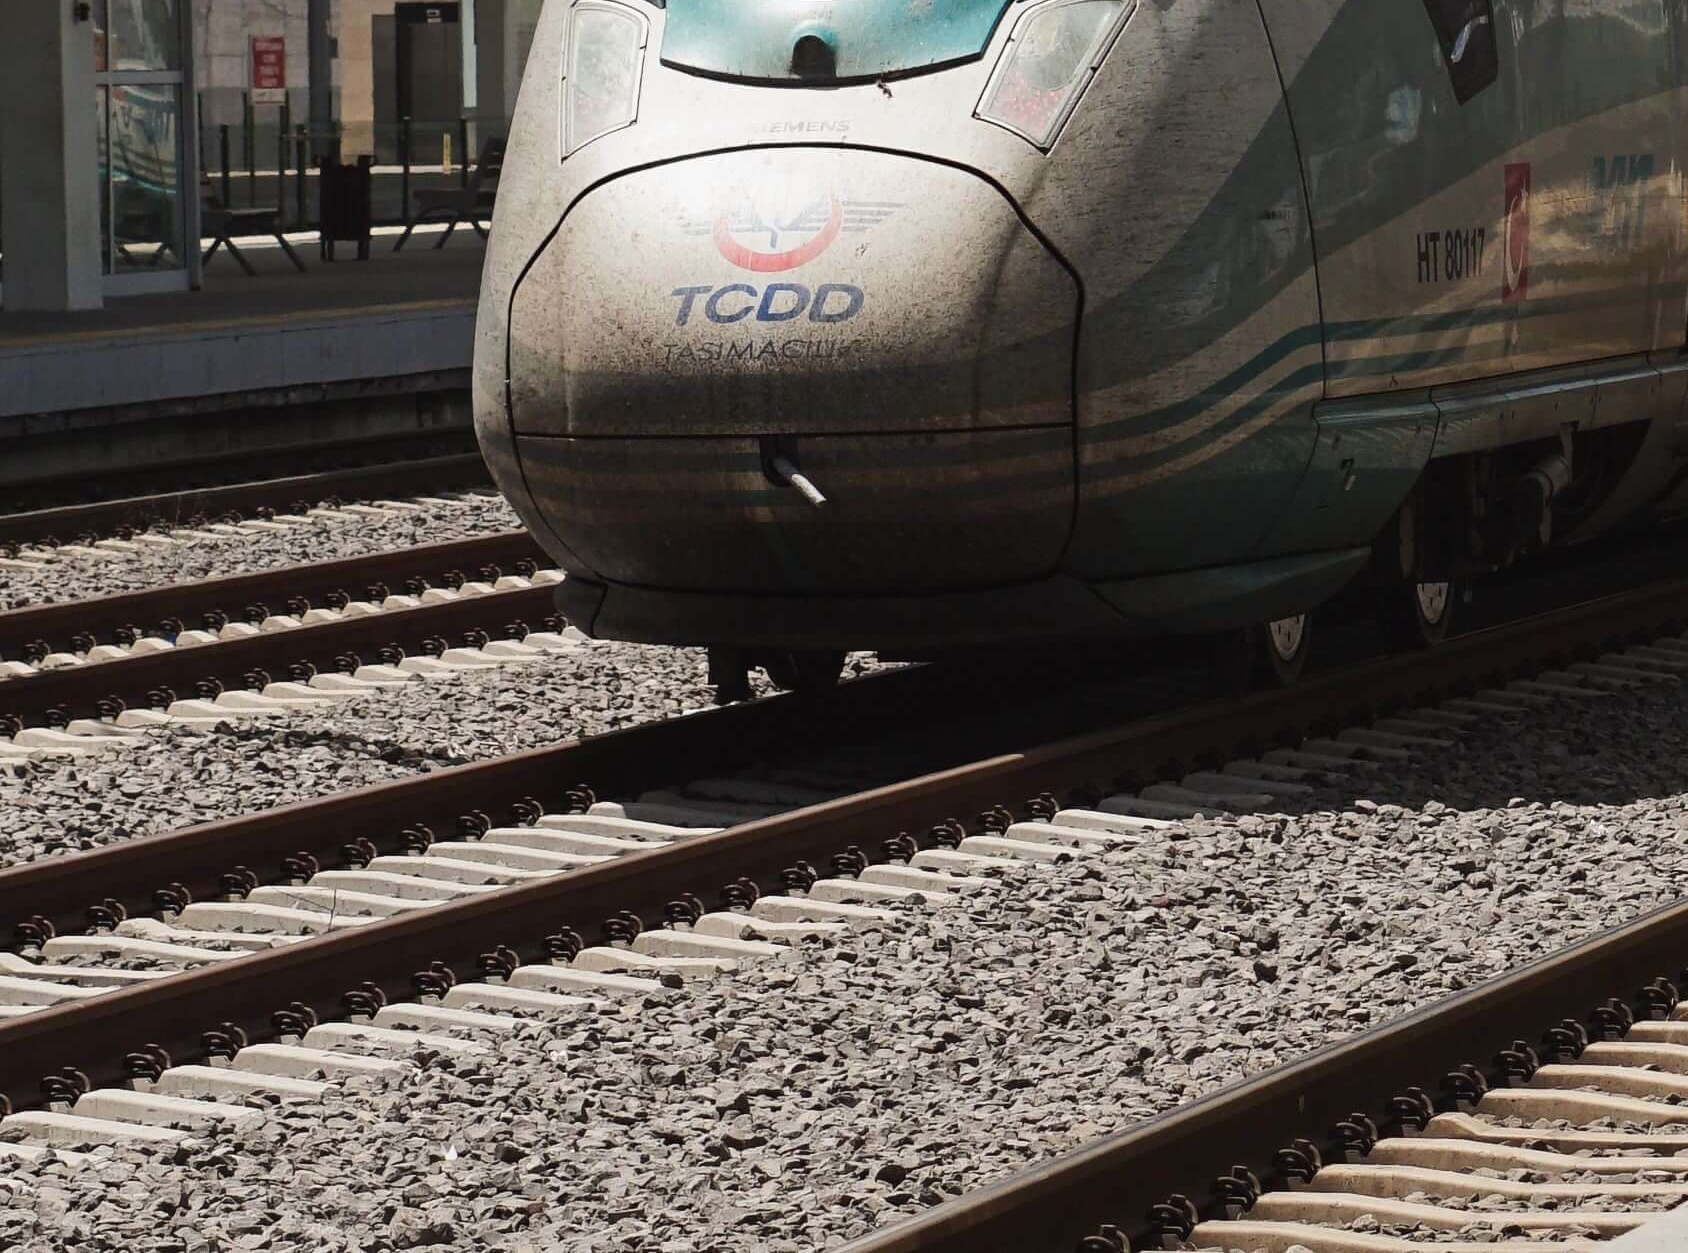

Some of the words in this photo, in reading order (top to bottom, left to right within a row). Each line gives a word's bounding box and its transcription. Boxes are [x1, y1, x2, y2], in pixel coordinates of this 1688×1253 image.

[1417, 232, 1440, 283] HT
[1445, 227, 1485, 281] 80117
[671, 283, 865, 326] TCDD
